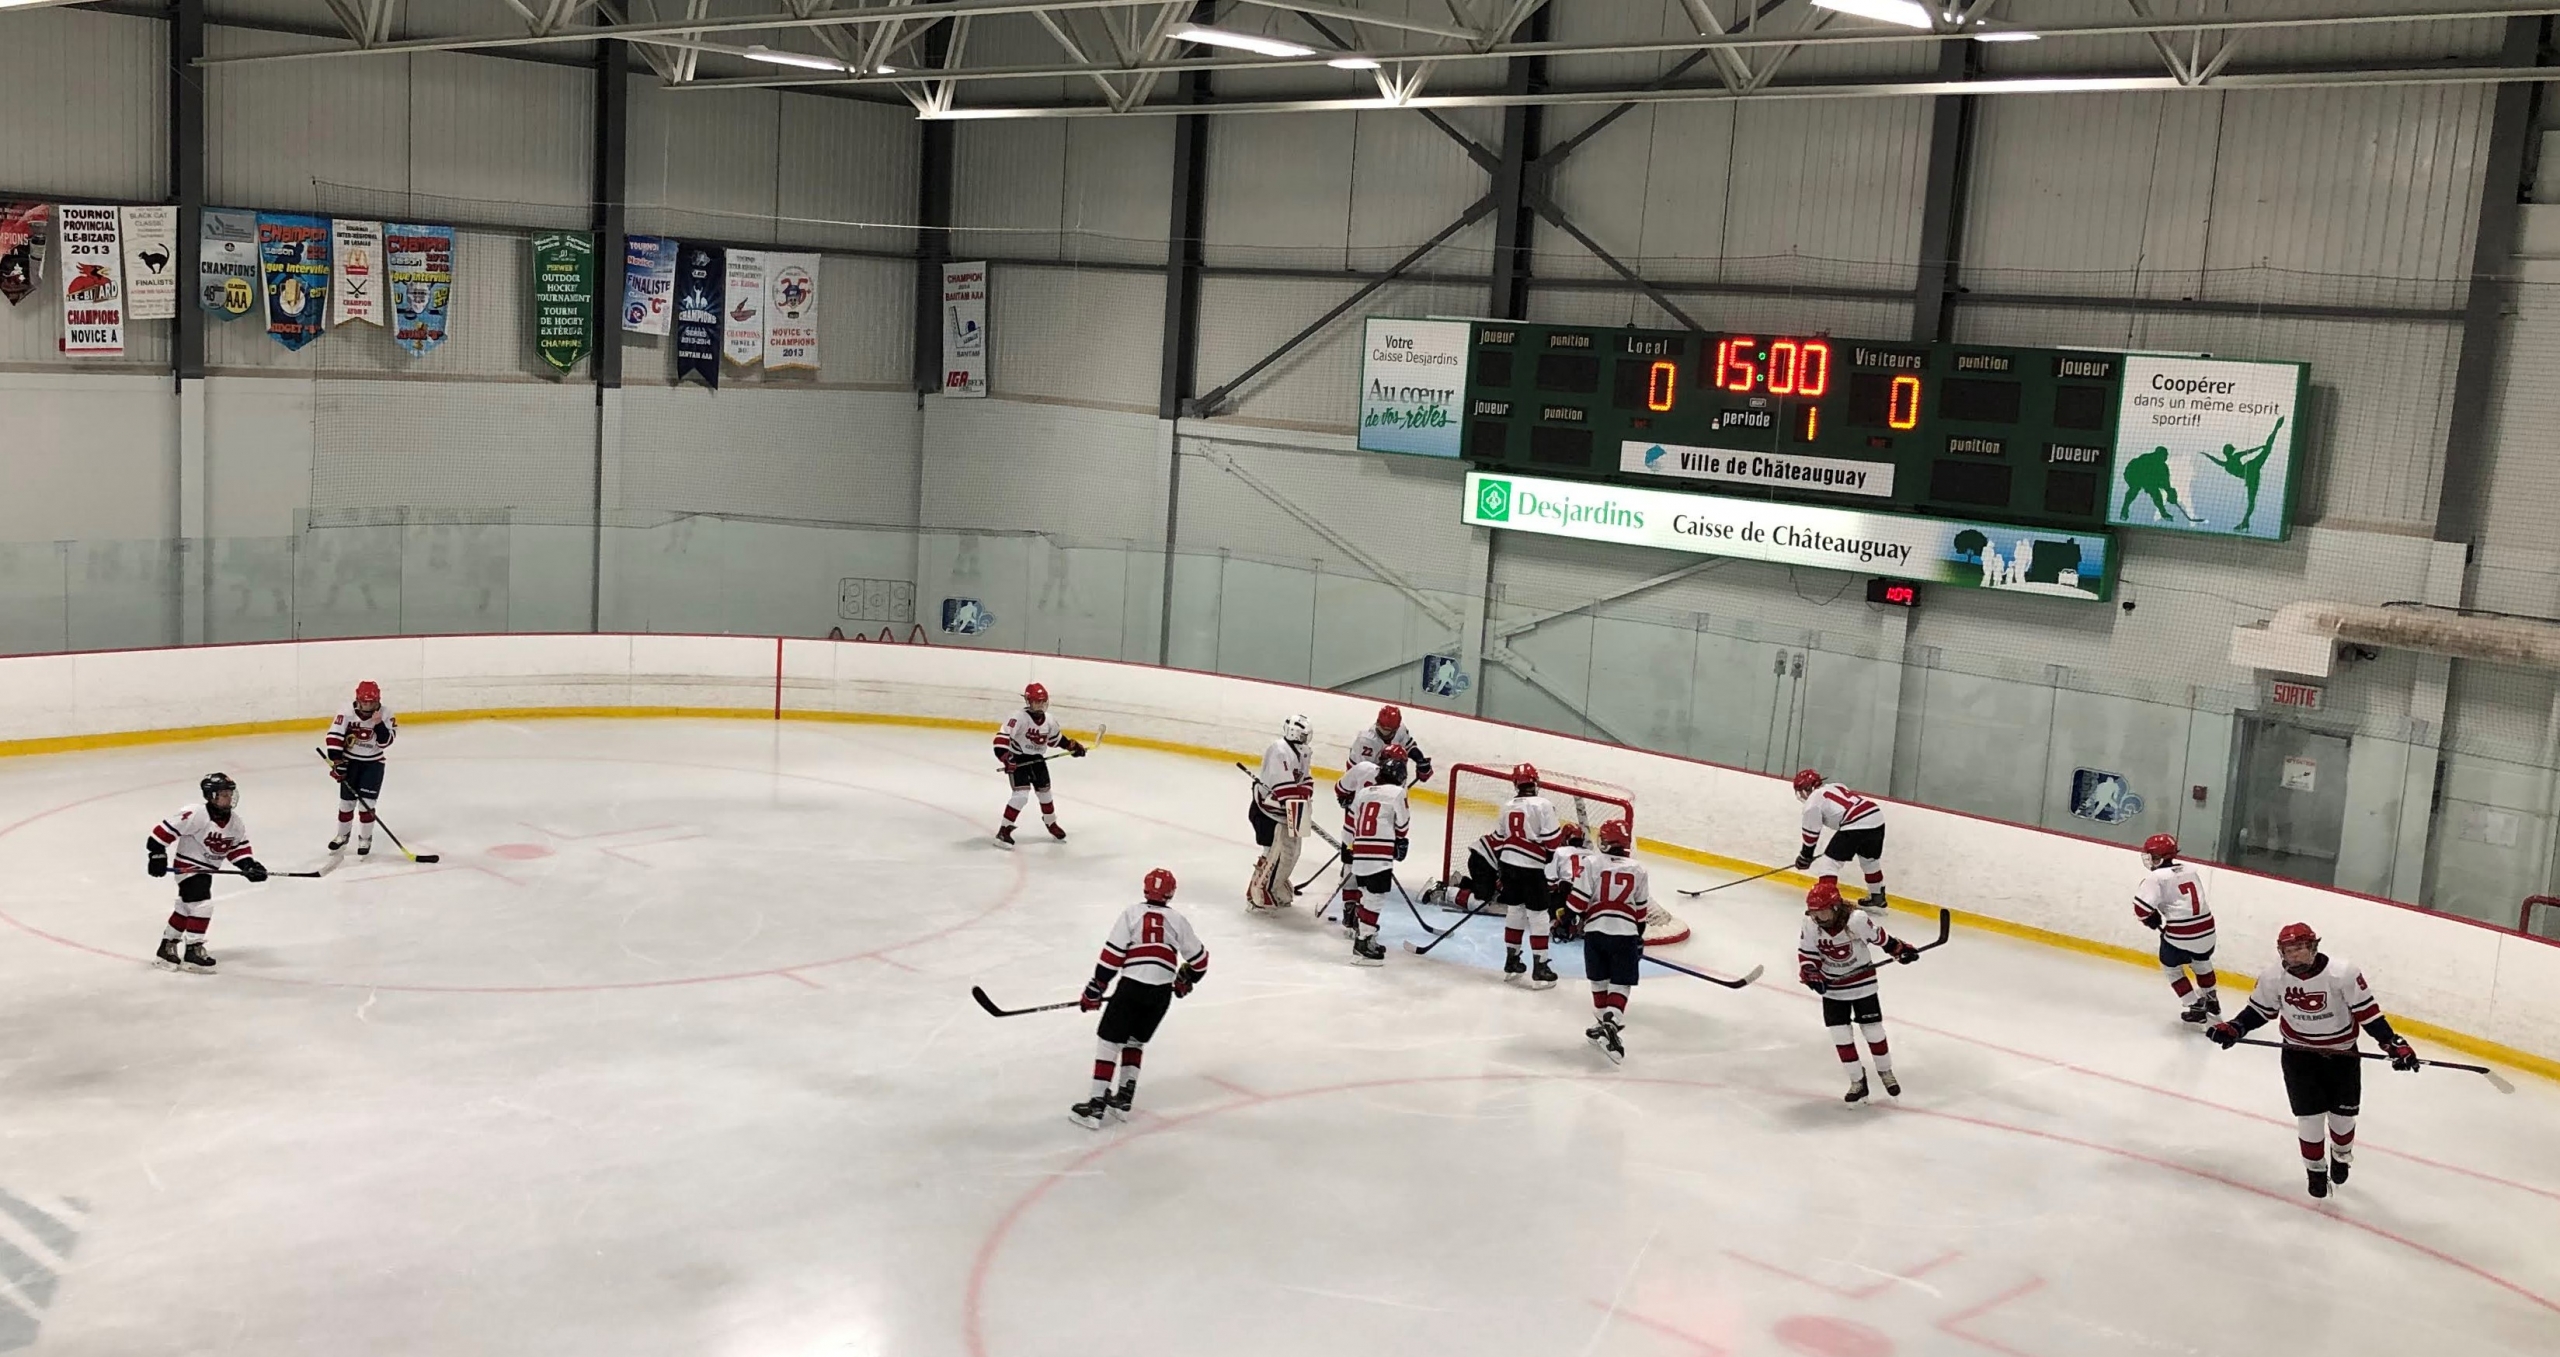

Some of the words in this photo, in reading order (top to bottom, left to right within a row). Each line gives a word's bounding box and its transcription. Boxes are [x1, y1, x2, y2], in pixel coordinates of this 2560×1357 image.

[63, 209, 114, 219] TOURNOI
[63, 220, 115, 231] PROVINCIAL
[71, 245, 110, 254] 2013
[201, 261, 256, 277] CHAMPIONS
[628, 256, 654, 268] Novice
[627, 274, 670, 295] FINALISTE
[947, 273, 983, 284] CHAMPION
[226, 291, 247, 309] AAA
[945, 292, 970, 301] BANTAM
[971, 291, 984, 299] AAA
[67, 310, 119, 325] CHAMPIONS
[71, 330, 107, 343] NOVICE
[111, 329, 118, 343] A
[770, 338, 815, 346] CHAMPIONS
[1385, 335, 1413, 349] Votre
[1479, 328, 1515, 345] joueur
[1550, 335, 1589, 348] punition
[783, 349, 804, 357] 2013
[1627, 336, 1668, 355] Local
[1373, 348, 1403, 362] Caisse
[1406, 351, 1458, 367] Desjardins
[1855, 348, 1921, 369] Visiteurs
[1958, 354, 2008, 370] punition
[1716, 339, 1828, 395] 15:00
[2058, 358, 2110, 378] joueur
[946, 371, 969, 387] IGA
[1649, 361, 1675, 411] 0
[2152, 373, 2236, 395] Coopérer
[1369, 378, 1395, 402] Au
[1474, 399, 1509, 415] joueur
[1889, 375, 1920, 430] 0
[2133, 393, 2164, 408] dans
[2170, 398, 2186, 409] un
[2191, 396, 2234, 412] même
[2238, 401, 2280, 417] esprit
[1365, 407, 1379, 428] de
[1544, 407, 1583, 421] punition
[1807, 405, 1818, 441] 1
[2152, 413, 2201, 427] sportif!
[1949, 438, 2000, 454] punition
[2048, 443, 2100, 463] joueur
[1680, 452, 1720, 474] Ville
[1726, 457, 1747, 475] de
[1751, 456, 1867, 489] Châteauguay
[1518, 491, 1645, 531] Desjardins
[1672, 513, 1735, 540] Caisse
[1741, 518, 1766, 544] de
[1772, 525, 1912, 567] Châteauguay
[2274, 684, 2318, 707] SORTIE
[1361, 746, 1373, 756] 22
[1356, 801, 1381, 837] 18
[1600, 870, 1635, 903] 12
[2178, 881, 2200, 916] 7
[1141, 911, 1165, 944] 6
